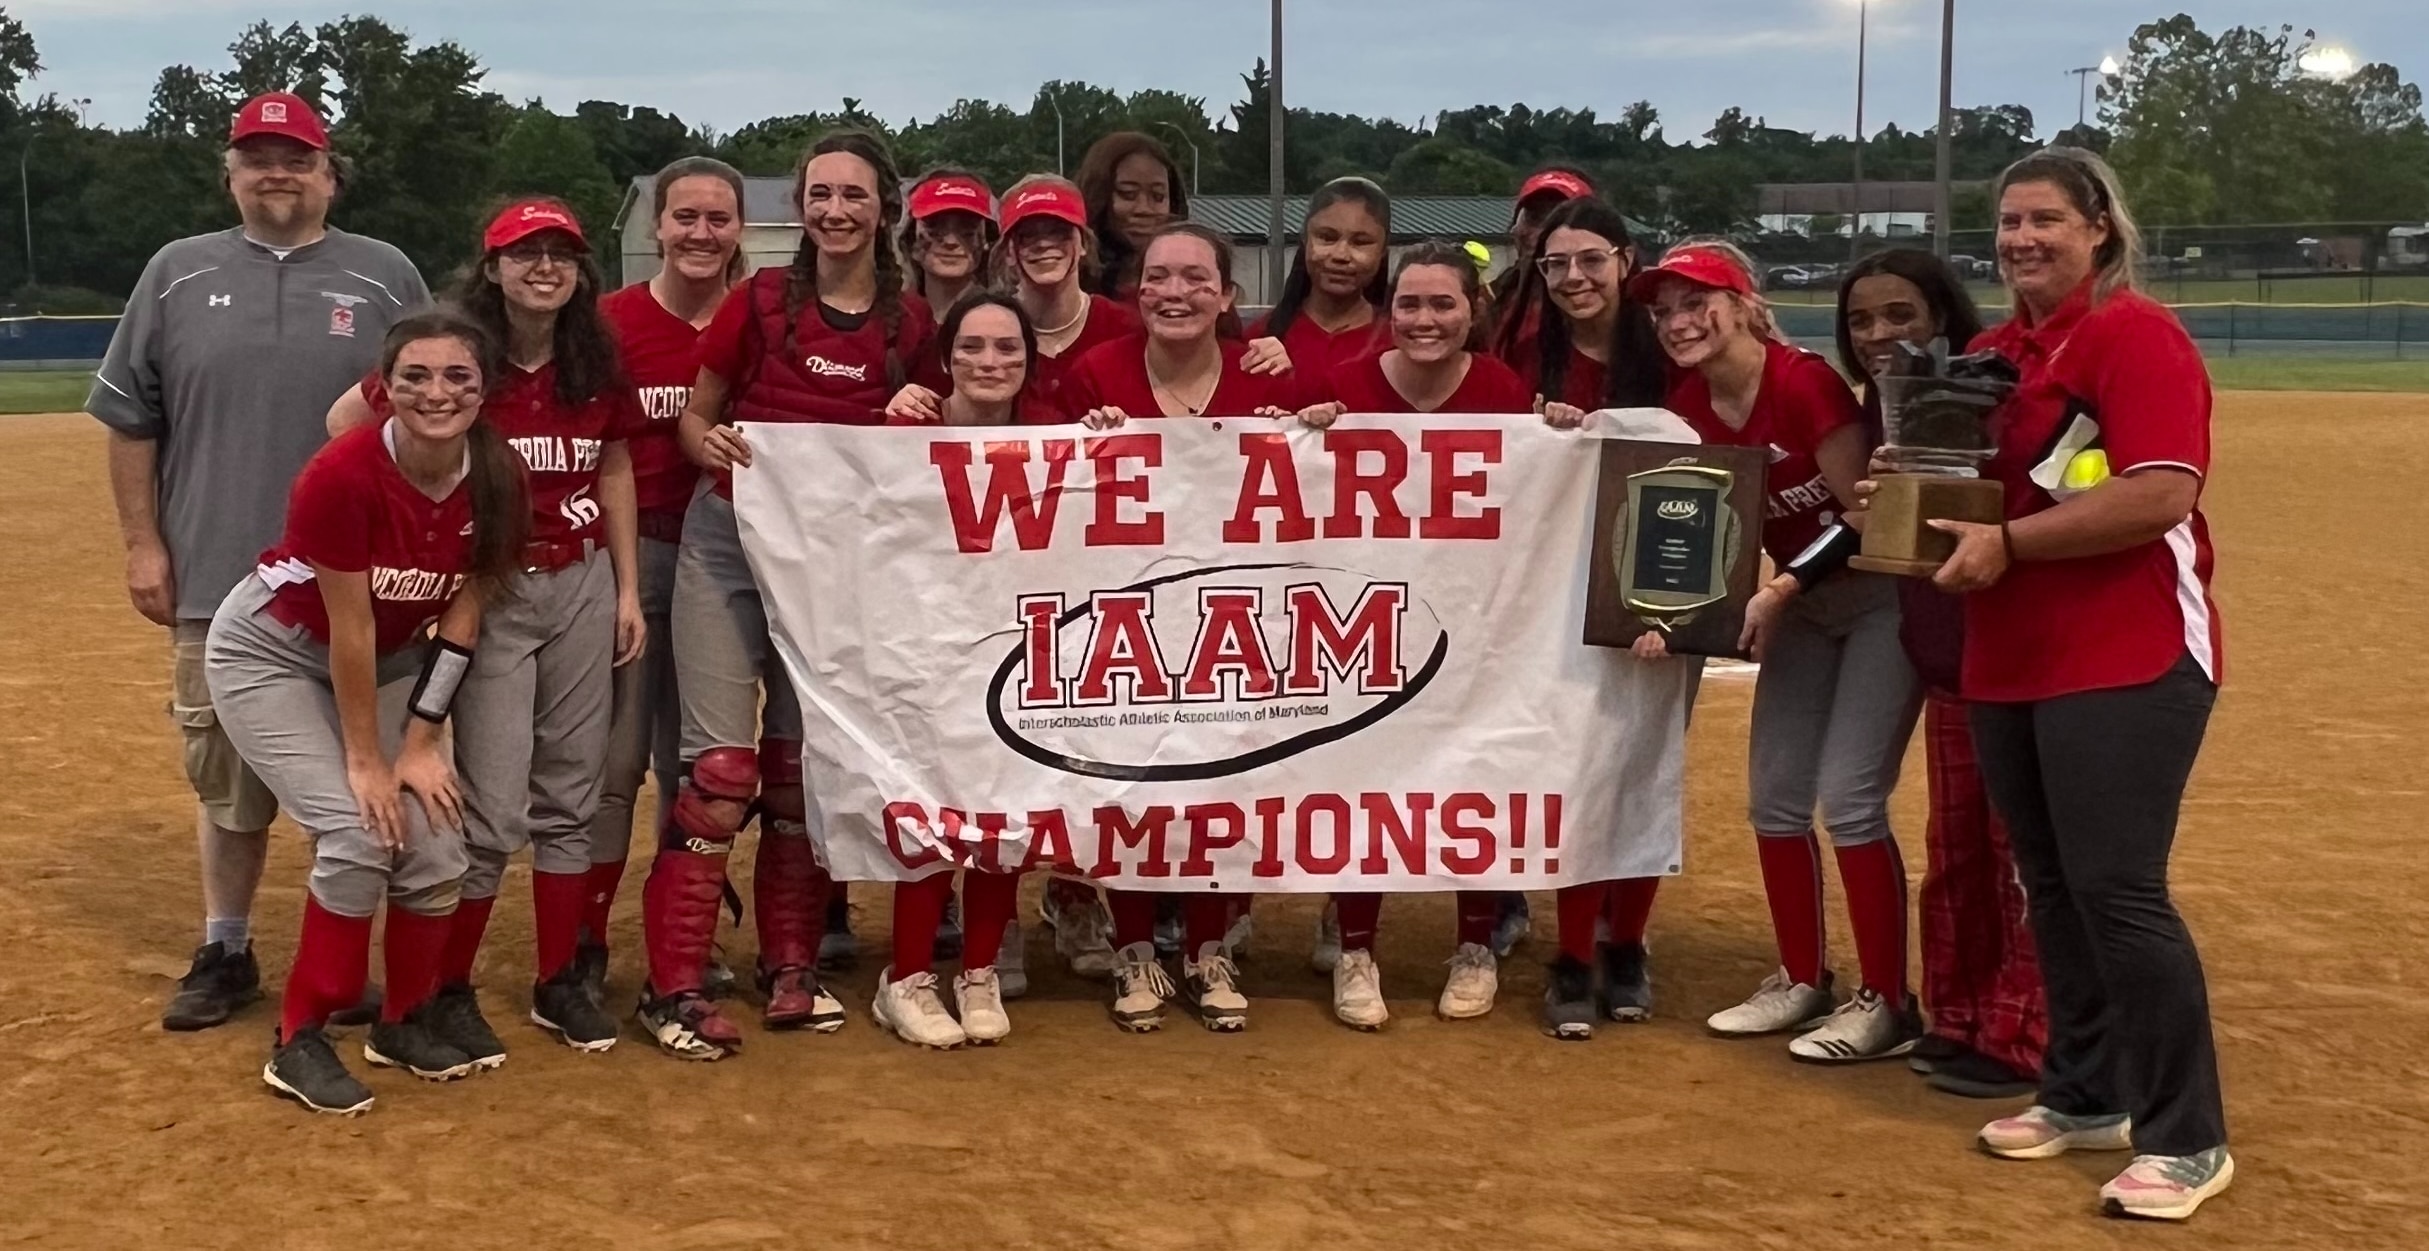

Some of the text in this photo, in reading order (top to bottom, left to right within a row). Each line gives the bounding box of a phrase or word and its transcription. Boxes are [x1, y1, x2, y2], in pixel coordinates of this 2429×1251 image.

[929, 428, 1503, 554] WE ARE
[1017, 581, 1409, 710] IAAM
[1119, 711, 1170, 726] Athletic
[1173, 708, 1251, 724] Association
[1254, 706, 1267, 721] of
[882, 792, 1563, 875] CHAMPIONS!!
